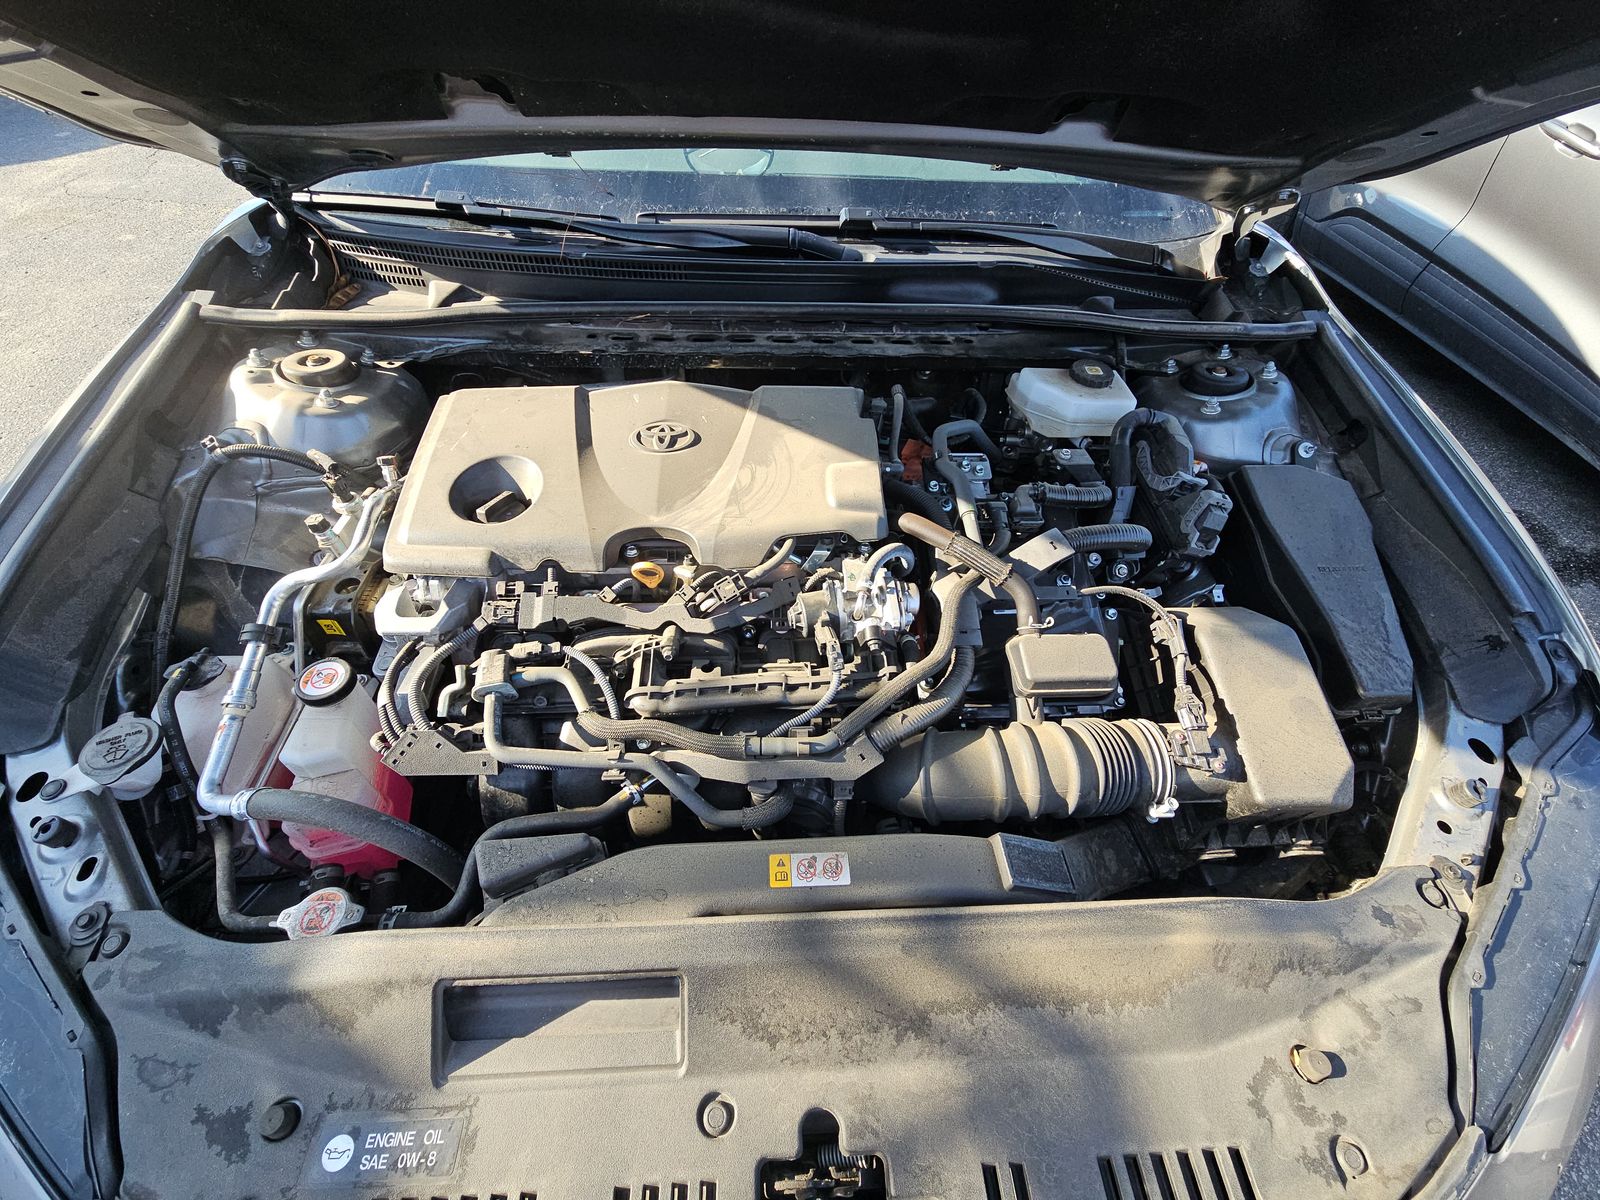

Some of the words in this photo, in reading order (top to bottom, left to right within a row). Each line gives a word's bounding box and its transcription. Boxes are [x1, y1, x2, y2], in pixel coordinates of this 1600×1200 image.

[365, 1131, 416, 1149] ENGINE
[424, 1129, 445, 1145] OIL
[360, 1154, 389, 1171] SAE
[397, 1151, 437, 1169] 0W-8
